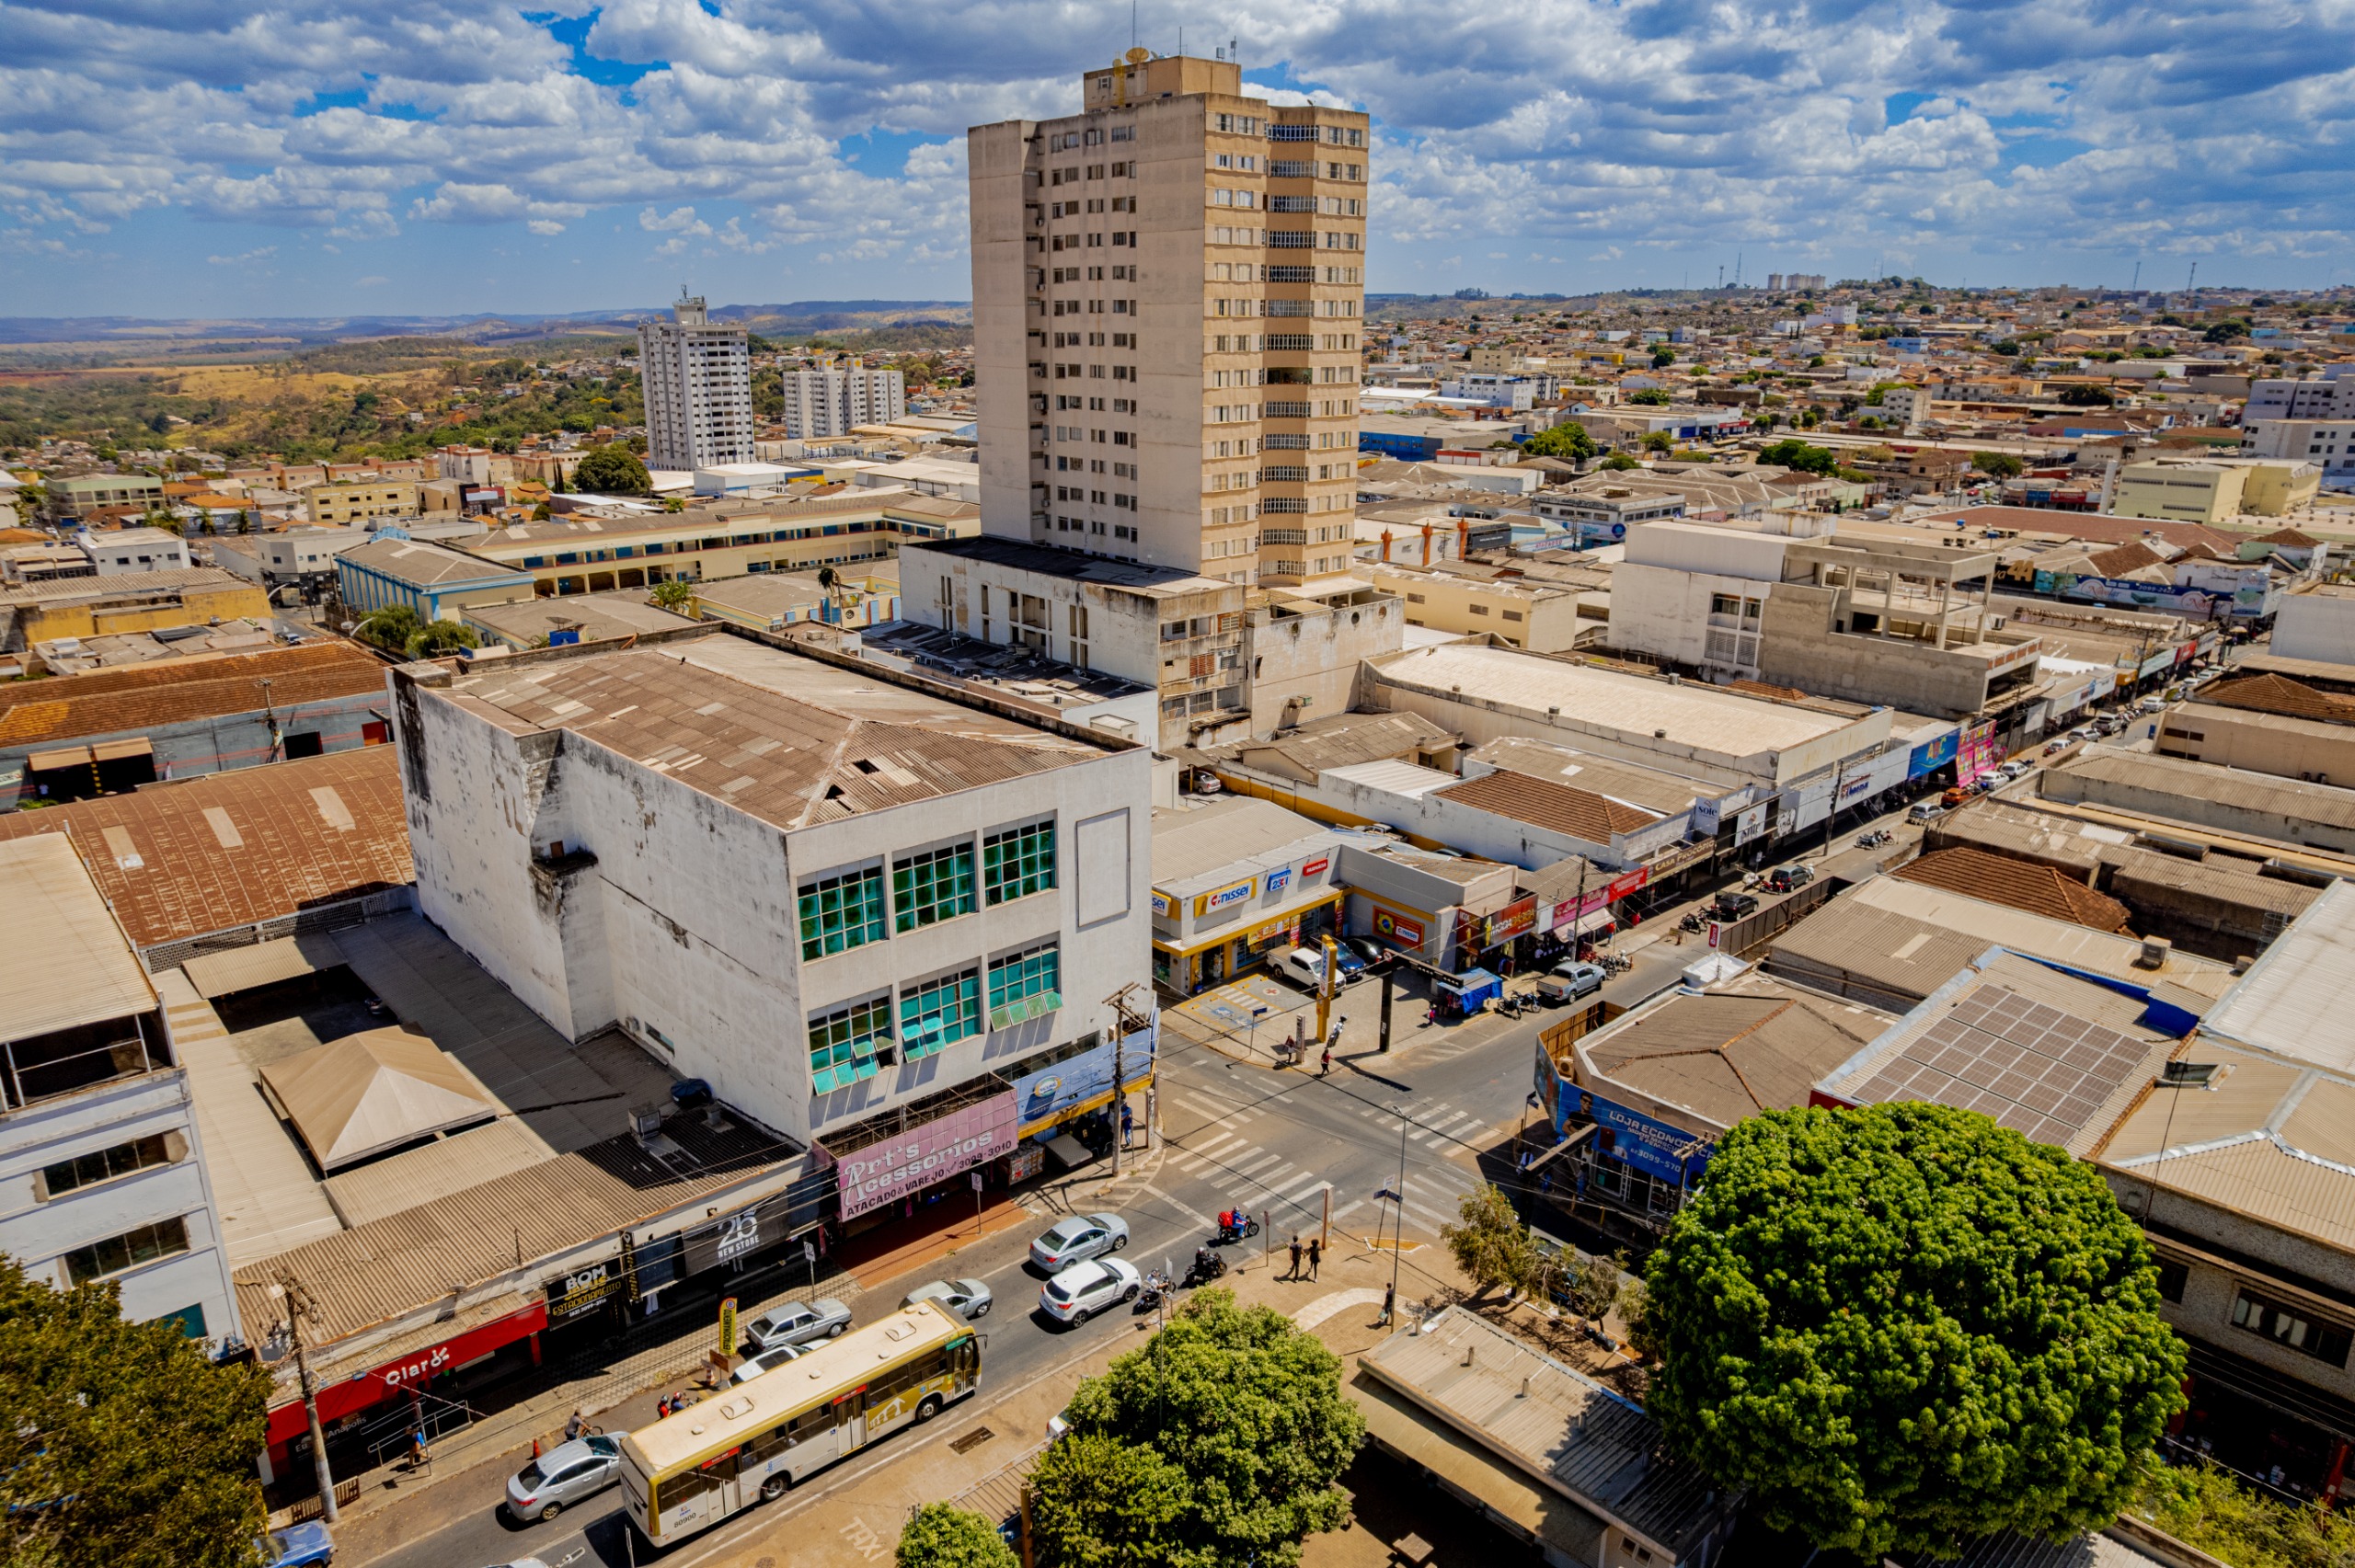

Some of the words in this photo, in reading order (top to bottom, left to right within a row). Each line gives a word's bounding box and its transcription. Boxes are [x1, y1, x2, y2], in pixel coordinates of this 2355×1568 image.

[1655, 857, 1675, 871] CASA
[1152, 896, 1166, 910] sei
[1221, 885, 1249, 905] nissei
[1609, 1110, 1640, 1129] LOJA
[1627, 1127, 1650, 1139] MODA
[844, 1134, 993, 1207] Acessórios
[1637, 1149, 1682, 1173] 3099-570
[846, 1190, 896, 1218] ATACADO
[904, 1169, 945, 1192] VAREJO
[959, 1139, 1012, 1171] 3099-3010
[718, 1246, 734, 1259] NEW
[736, 1234, 760, 1252] STORE
[566, 1265, 607, 1290] BOM
[552, 1281, 622, 1316] ESTACIONAMENTO
[723, 1310, 732, 1351] ESTACIONAMENTO
[385, 1349, 444, 1385] Claro
[327, 1416, 367, 1438] Anápolis
[673, 1512, 697, 1528] 80900
[839, 1516, 890, 1562] TAXI
